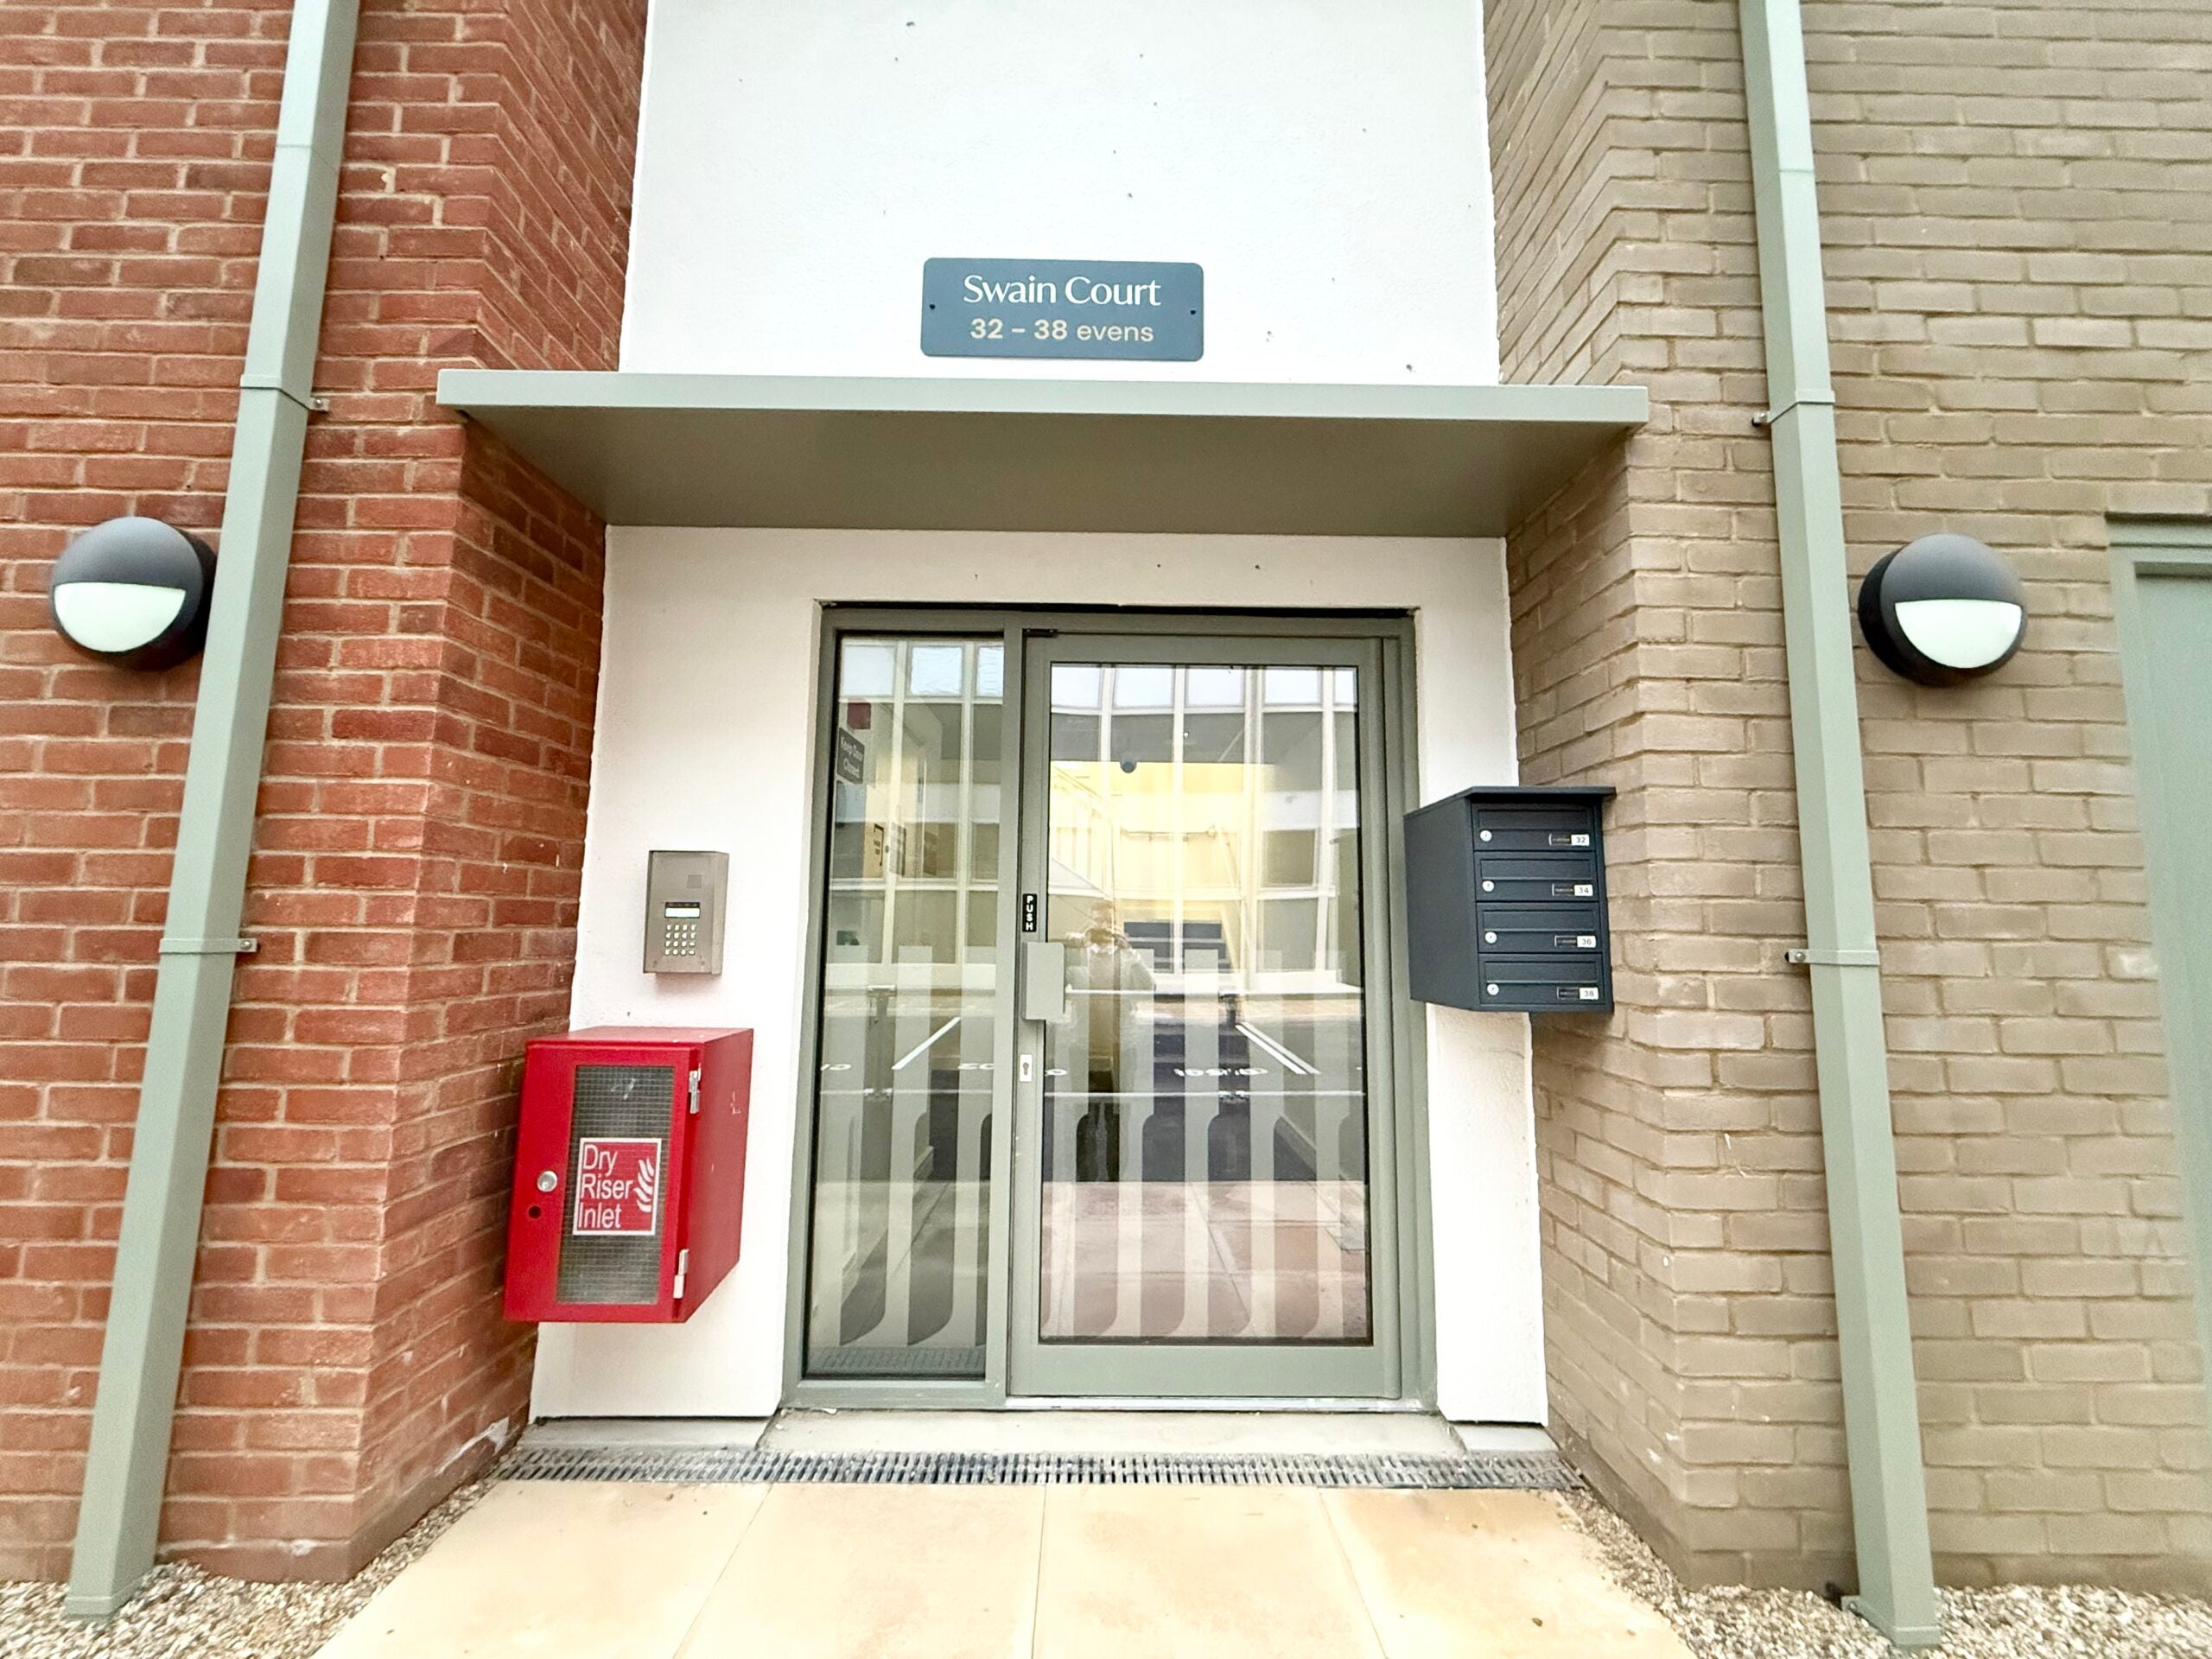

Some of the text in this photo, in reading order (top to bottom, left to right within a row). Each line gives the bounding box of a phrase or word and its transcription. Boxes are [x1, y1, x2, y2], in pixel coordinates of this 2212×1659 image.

[963, 274, 1162, 306] Swain Court
[969, 318, 1004, 340] 32
[1034, 319, 1068, 340] 38
[1077, 325, 1154, 342] evens
[1025, 895, 1034, 931] PUSH
[582, 1144, 619, 1177] Dry
[580, 1174, 633, 1199] Riser
[578, 1204, 622, 1228] Inlet
